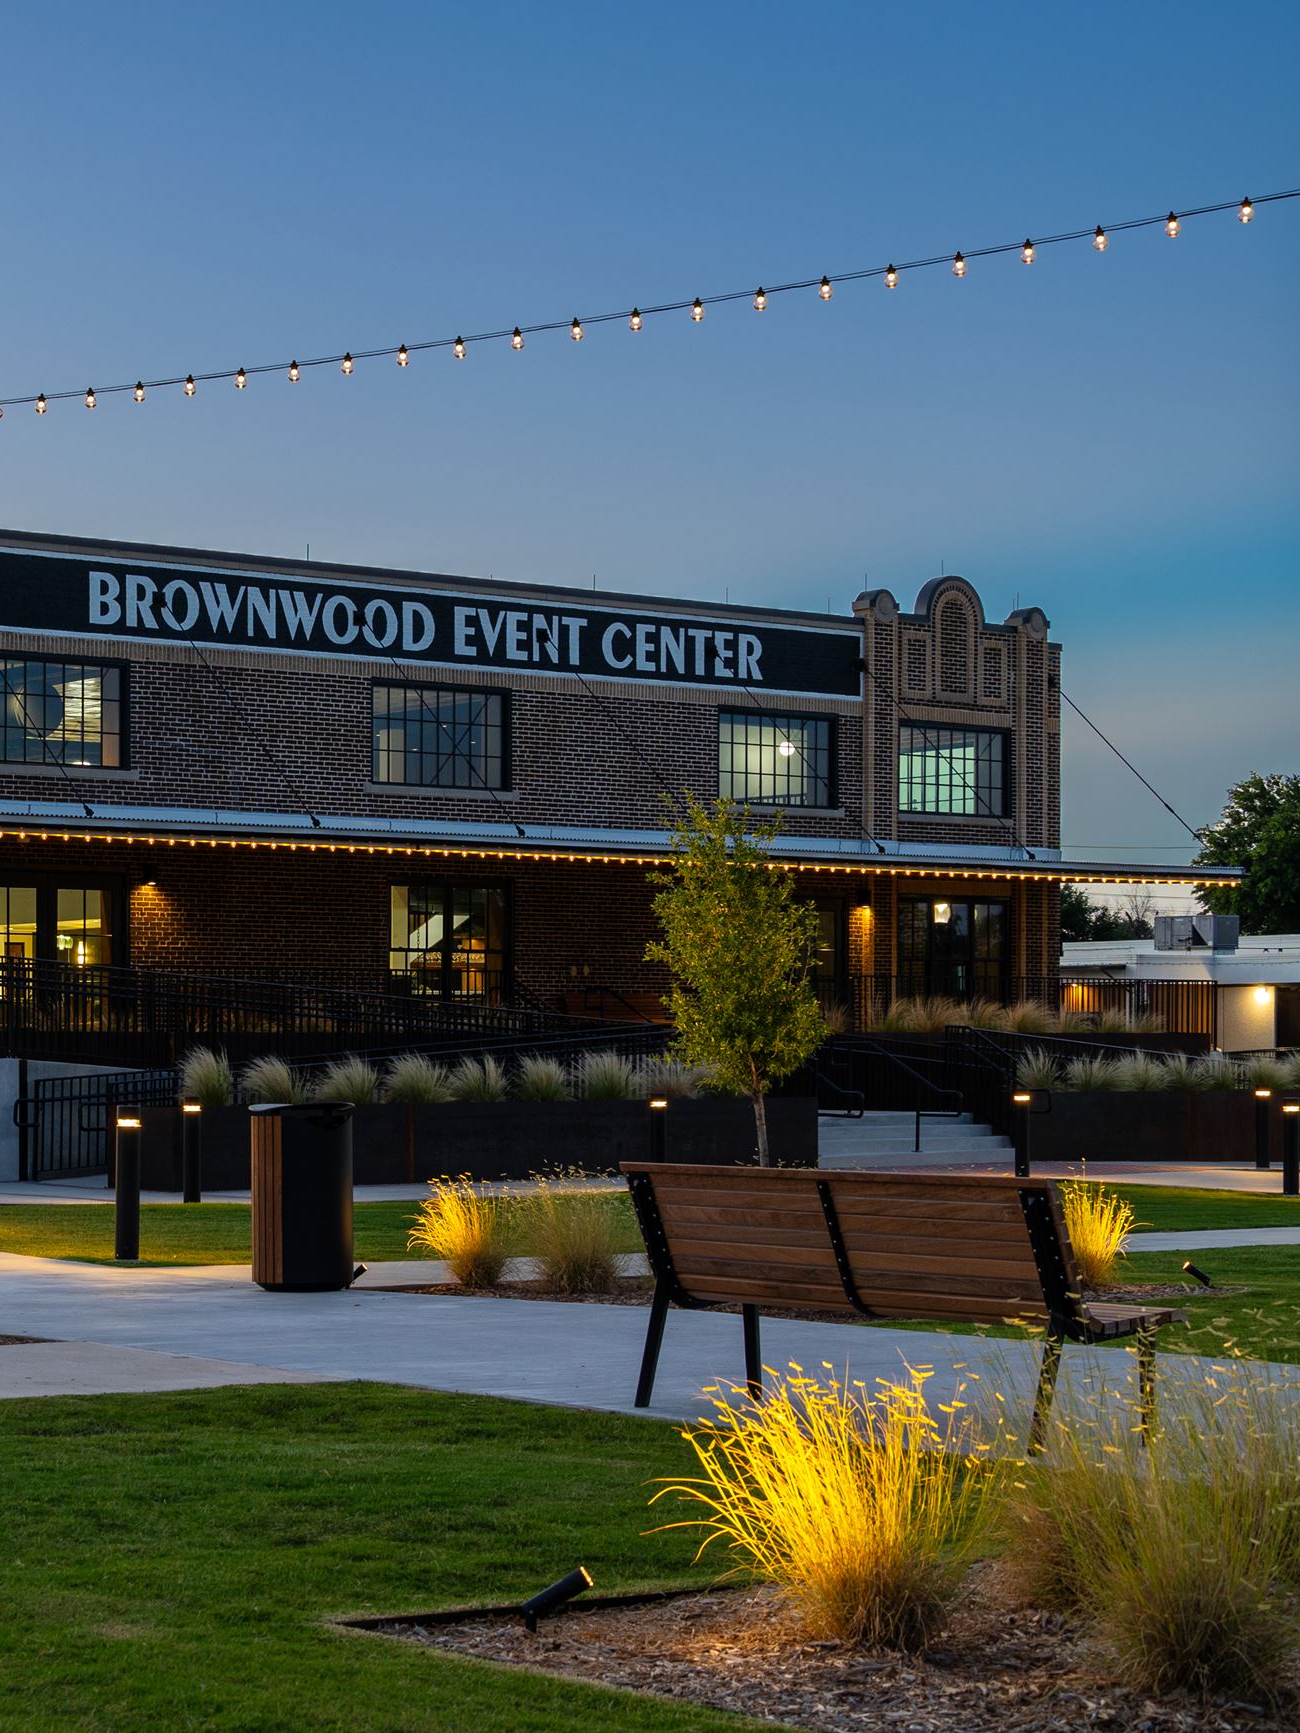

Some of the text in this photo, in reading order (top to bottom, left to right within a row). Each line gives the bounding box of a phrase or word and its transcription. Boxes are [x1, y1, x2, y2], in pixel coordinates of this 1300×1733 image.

[88, 570, 764, 681] BROWNWOOD EVENT CENTER
